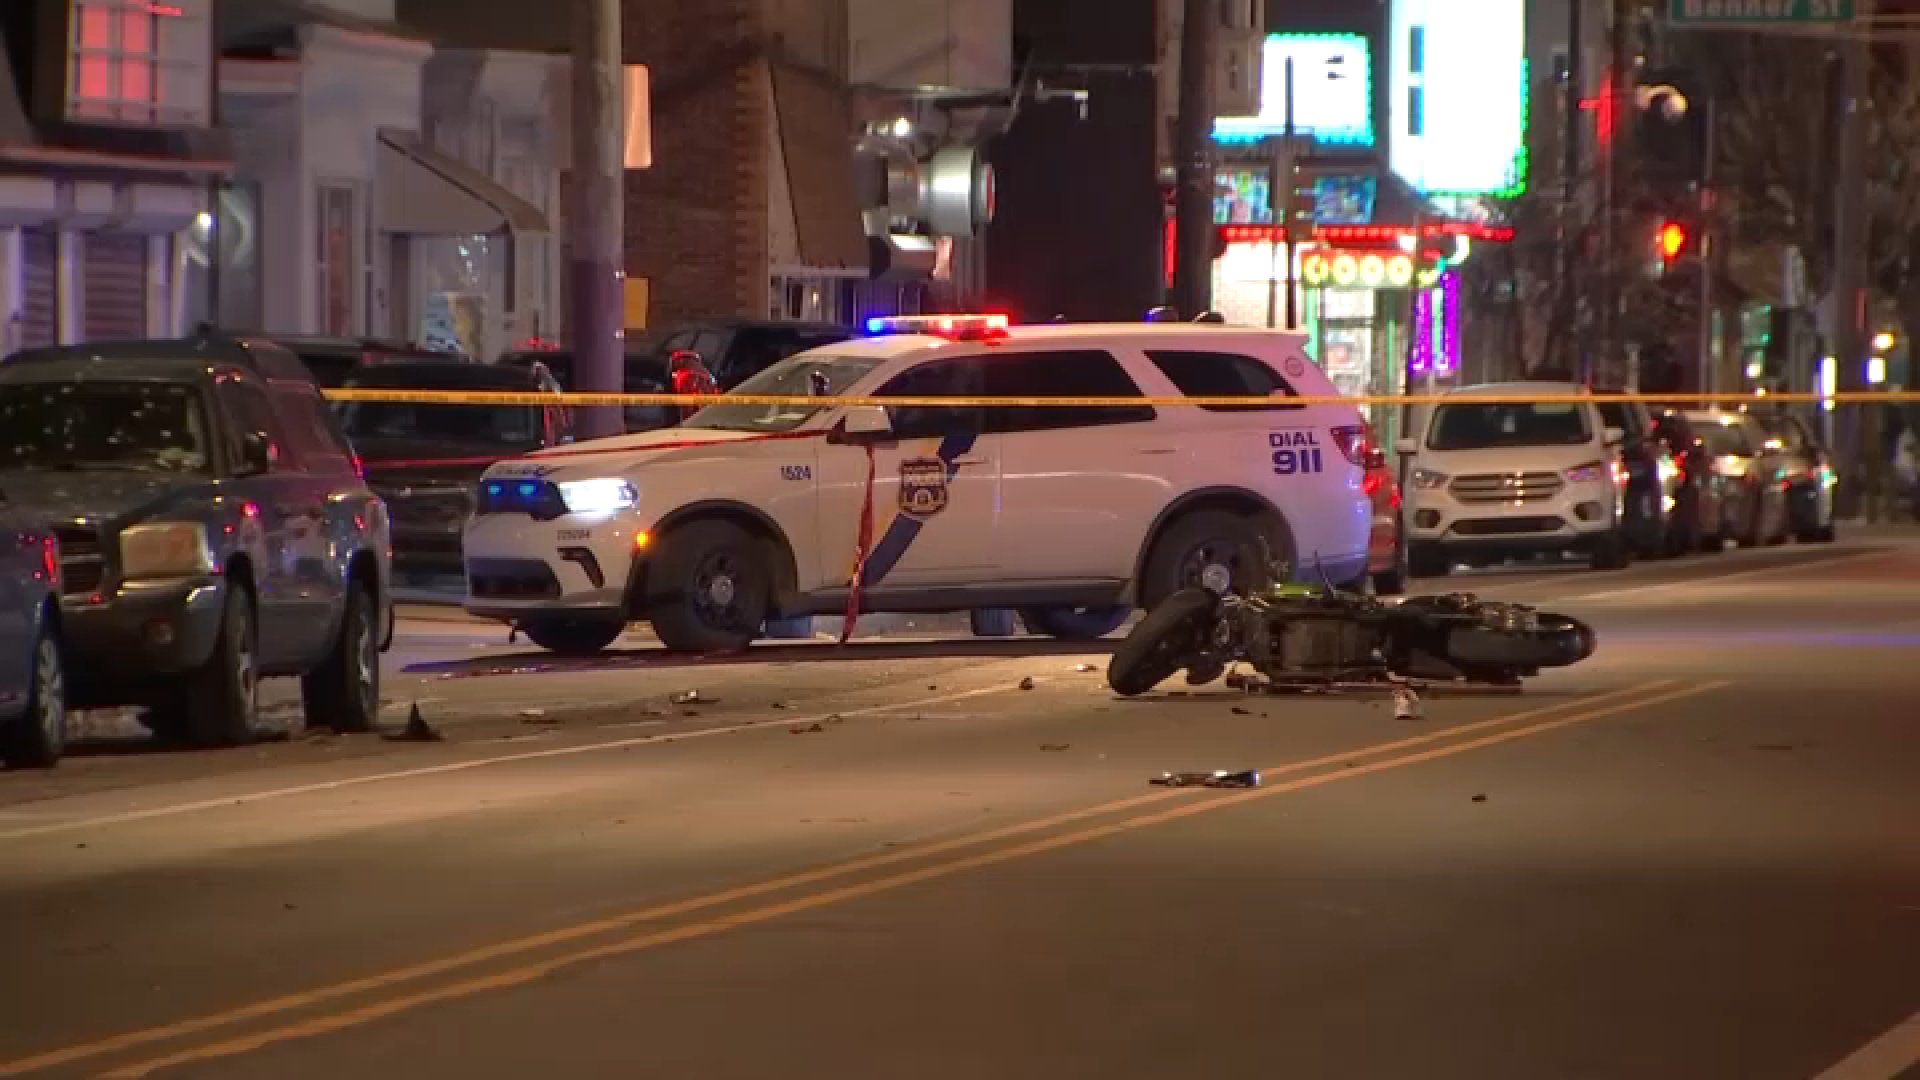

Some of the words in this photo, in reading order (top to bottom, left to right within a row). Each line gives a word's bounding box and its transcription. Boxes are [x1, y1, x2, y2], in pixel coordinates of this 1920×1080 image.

[1269, 432, 1320, 447] DIAL
[1272, 449, 1323, 474] 911
[780, 465, 812, 481] 1524
